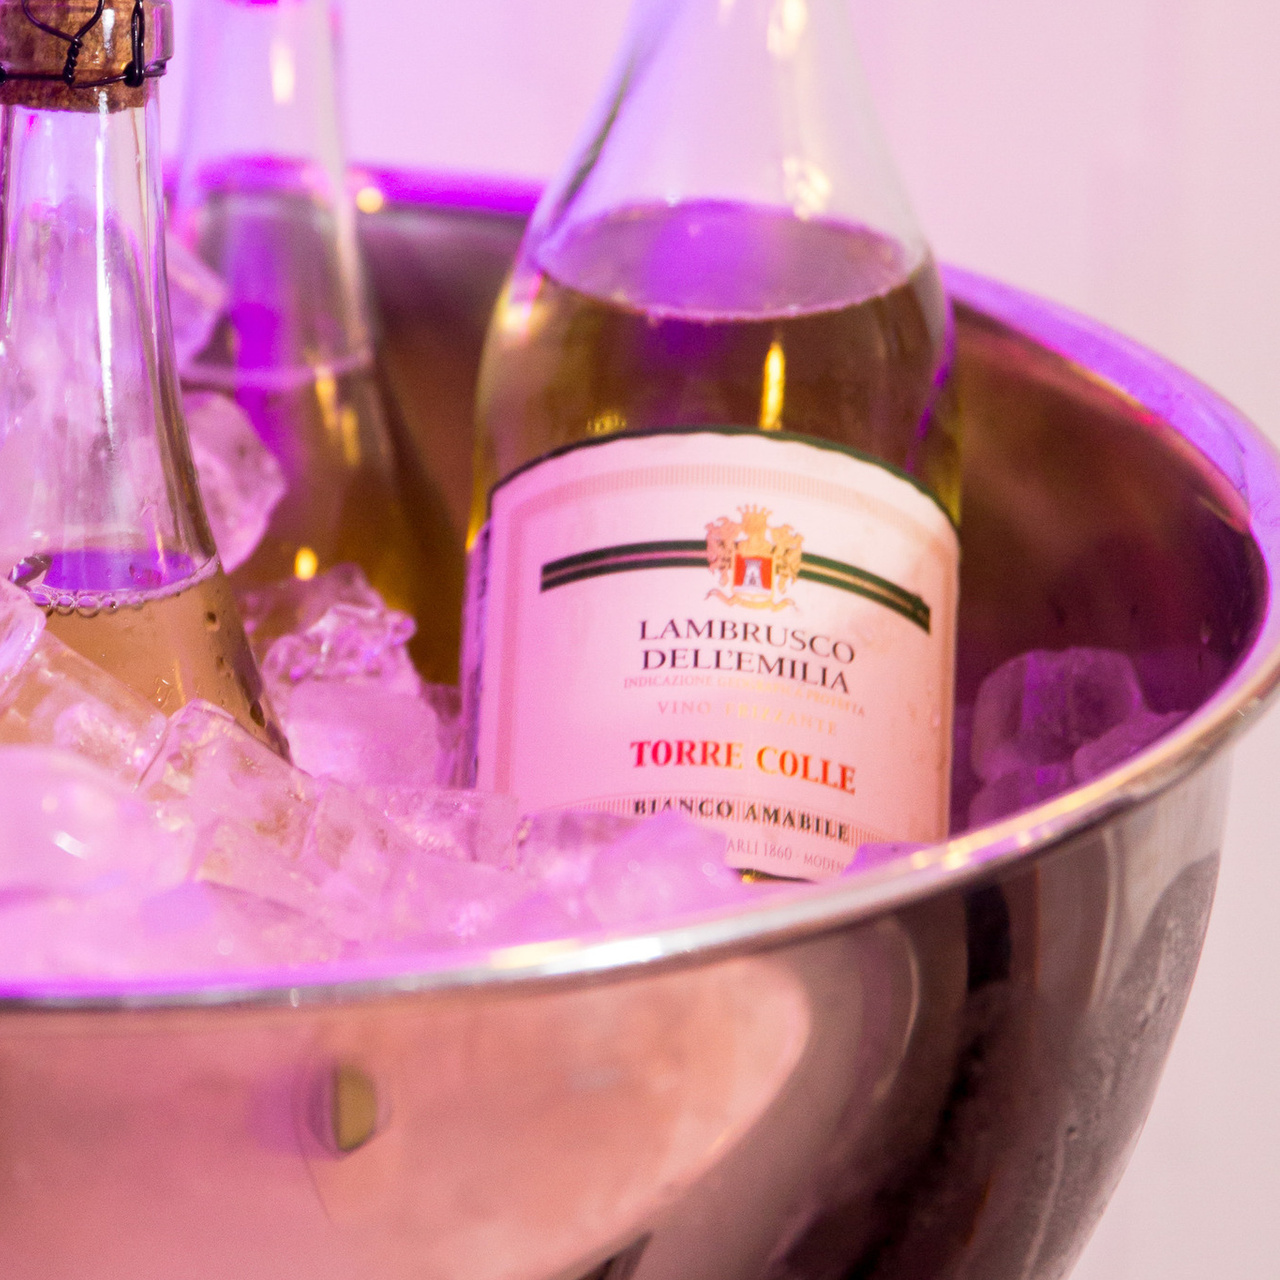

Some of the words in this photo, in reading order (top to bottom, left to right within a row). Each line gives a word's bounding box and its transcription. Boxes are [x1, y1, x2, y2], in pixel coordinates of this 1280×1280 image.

[639, 618, 855, 665] LAMBRUSCO
[623, 675, 712, 689] INDICAZIONE
[641, 648, 851, 695] DELL'EMILIA
[657, 700, 712, 715] VINO
[630, 739, 743, 770] TORRE
[755, 745, 857, 796] COLLE
[633, 799, 733, 819] BIANCO
[744, 804, 851, 843] AMABILE
[726, 838, 759, 856] ARLI
[764, 842, 793, 861] 1860
[803, 852, 845, 873] MODEN
